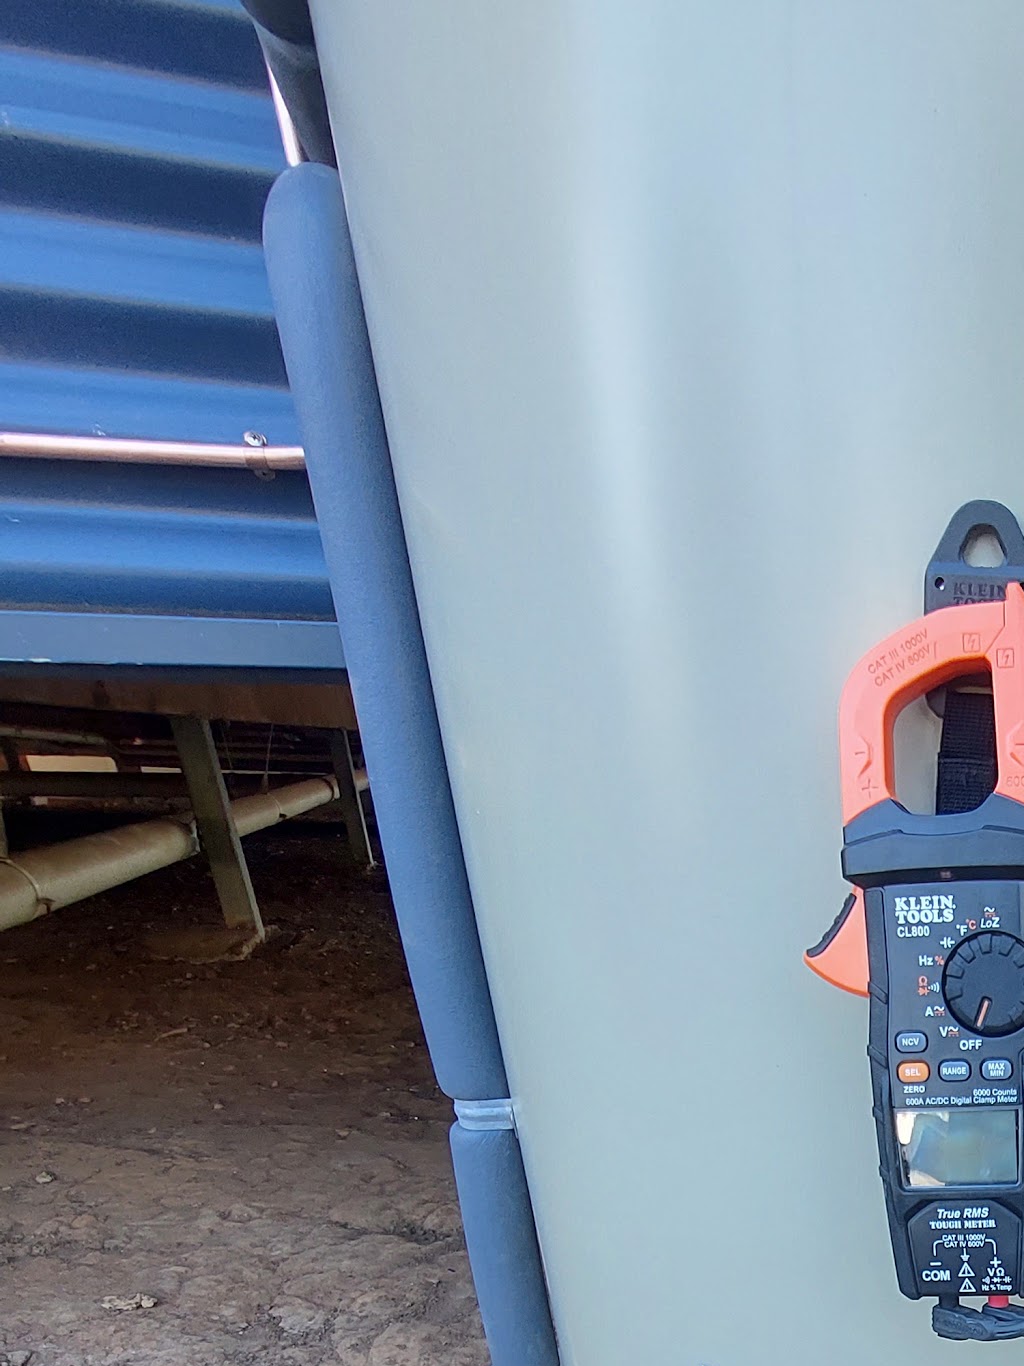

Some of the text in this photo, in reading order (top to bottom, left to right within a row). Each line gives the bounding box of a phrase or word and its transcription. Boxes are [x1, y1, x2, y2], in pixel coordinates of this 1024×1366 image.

[868, 655, 887, 674] CAT
[900, 628, 929, 653] 1000V
[874, 668, 894, 687] CAT
[894, 661, 905, 673] IV
[895, 896, 955, 911] KLEIN
[896, 909, 954, 925] TOOLS
[981, 917, 1000, 929] LoZ
[897, 926, 930, 938] CL800
[918, 956, 933, 966] Hz
[902, 1038, 919, 1046] NCV
[960, 1040, 982, 1051] OFF
[904, 1068, 921, 1077] SEL
[942, 1066, 966, 1075] RANGE
[904, 1086, 925, 1094] ZERO
[992, 1088, 1017, 1096] Counts
[906, 1098, 924, 1106] 600A
[926, 1097, 950, 1105] AC/DC
[950, 1096, 972, 1106] Digital
[974, 1096, 996, 1105] Clamp
[937, 1207, 989, 1219] True RMS
[930, 1220, 996, 1229] TOUGH METER
[922, 1270, 950, 1281] COM
